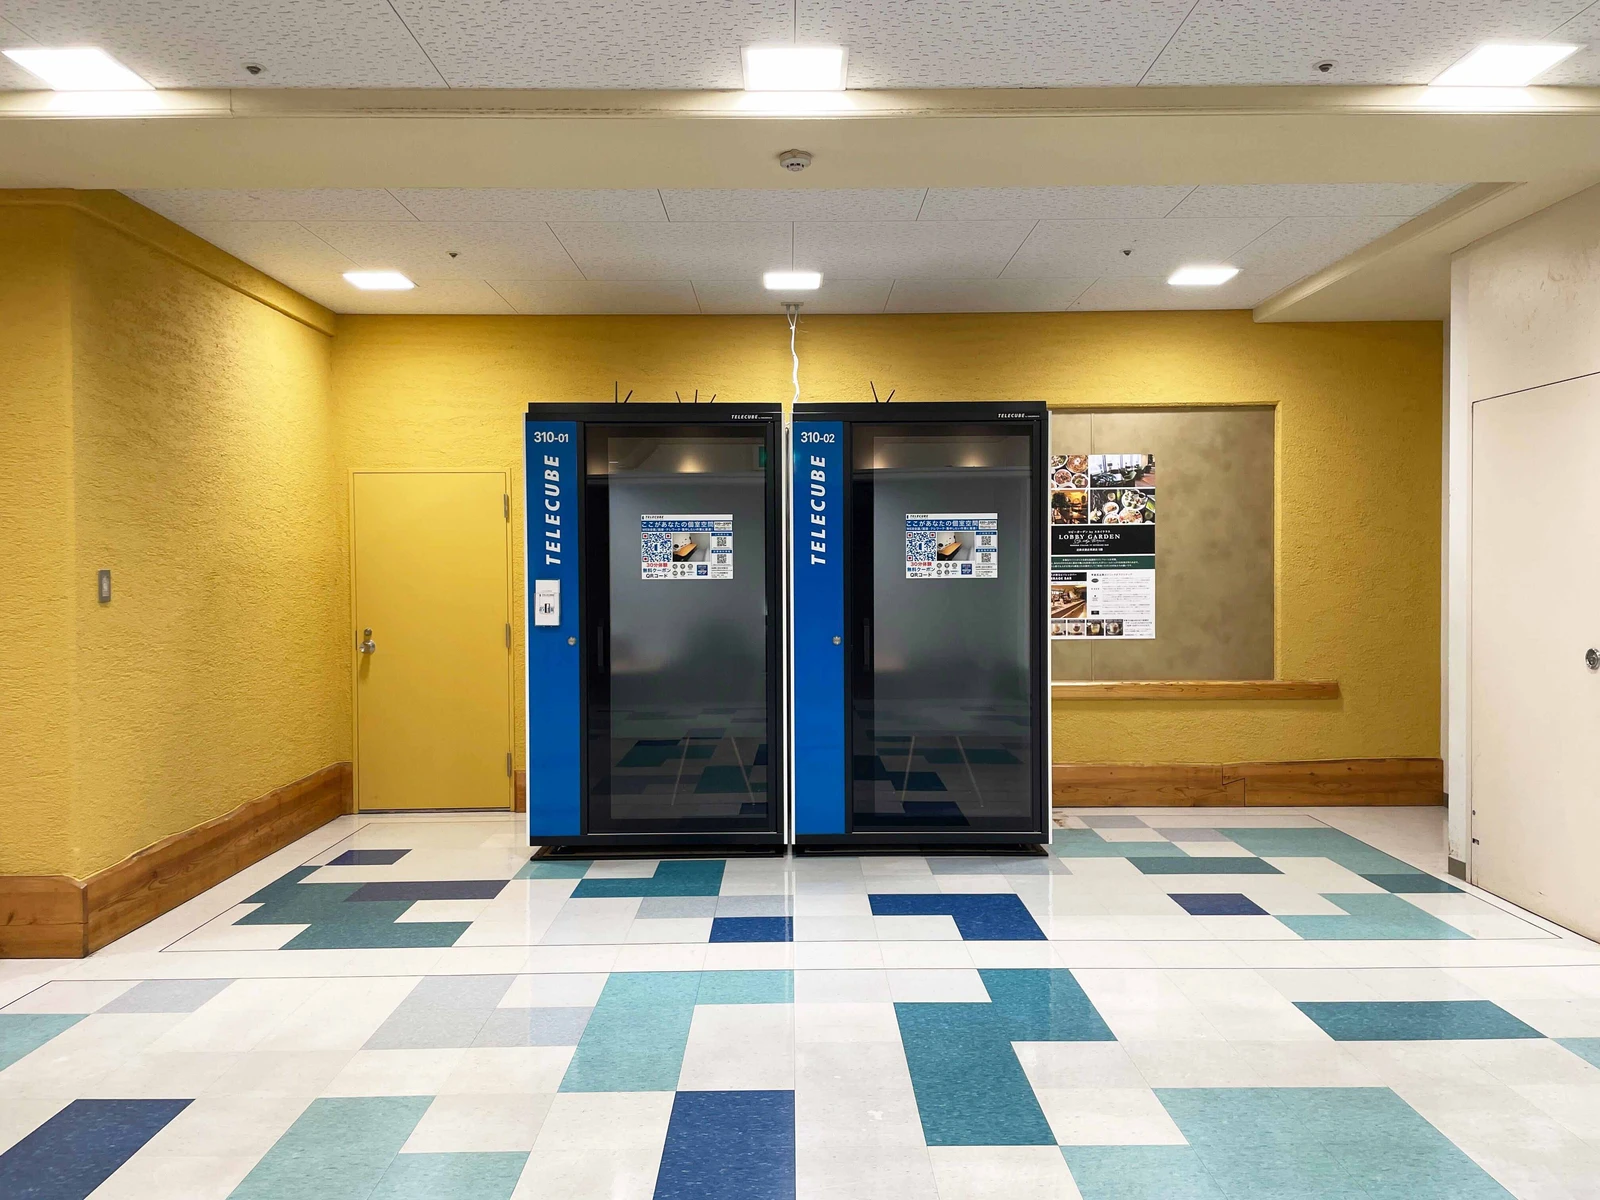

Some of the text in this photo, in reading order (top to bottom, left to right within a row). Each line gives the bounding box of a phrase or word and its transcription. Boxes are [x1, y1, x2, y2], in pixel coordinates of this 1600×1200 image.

[534, 431, 569, 443] 310-01
[800, 431, 835, 443] 310-02
[544, 455, 561, 566] TELECUBE
[810, 455, 826, 565] TELECUBE
